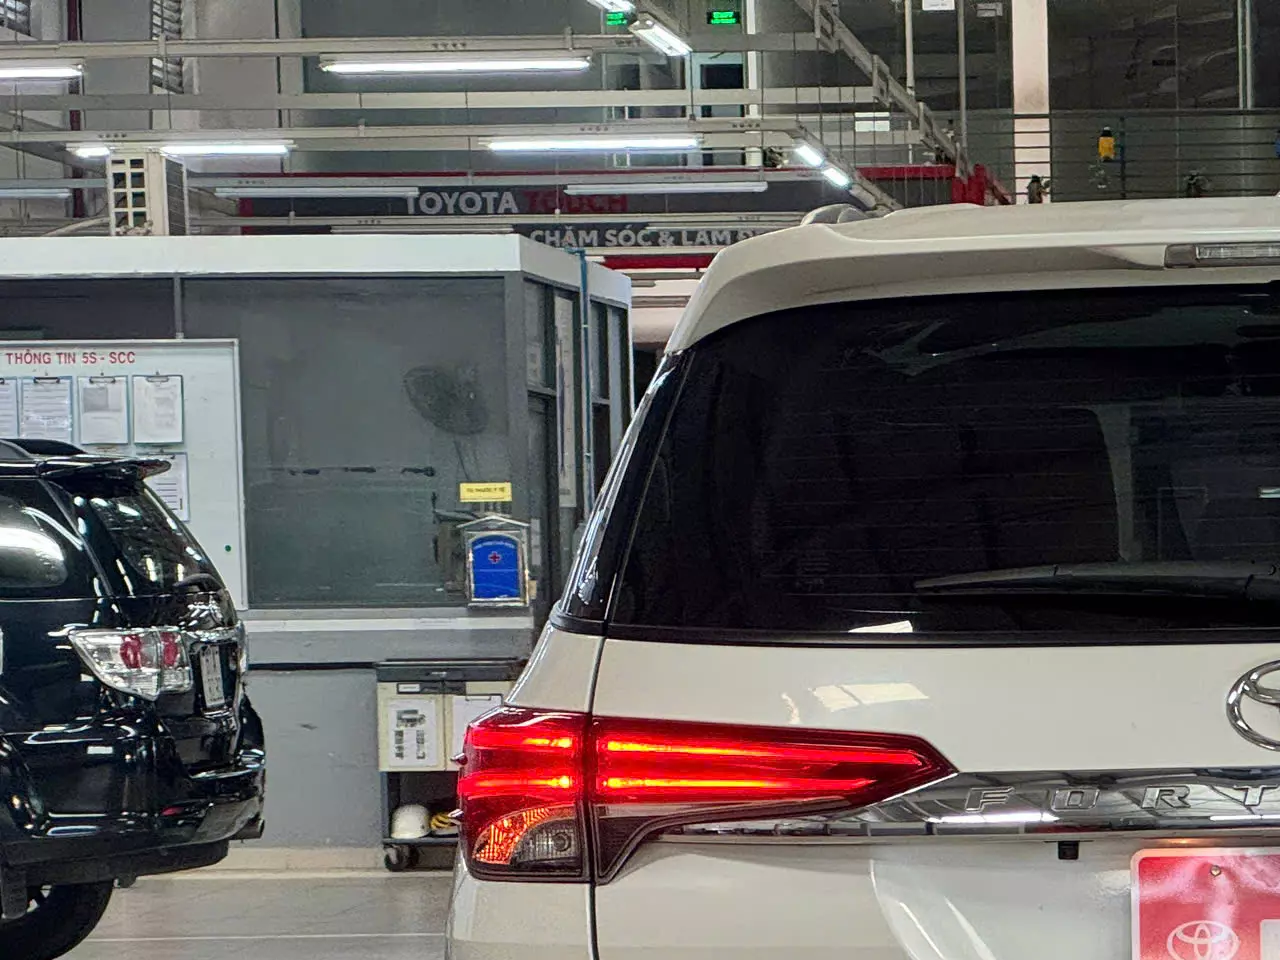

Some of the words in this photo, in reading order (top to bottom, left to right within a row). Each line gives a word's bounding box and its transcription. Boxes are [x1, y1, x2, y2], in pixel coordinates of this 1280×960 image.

[407, 191, 519, 214] TOYOTA
[530, 224, 598, 247] CHĂM
[605, 224, 654, 247] SÓC
[658, 230, 675, 247] &
[6, 349, 52, 364] THÔNG
[56, 352, 76, 364] TIN
[82, 351, 97, 364] 5S
[109, 351, 136, 364] SCC
